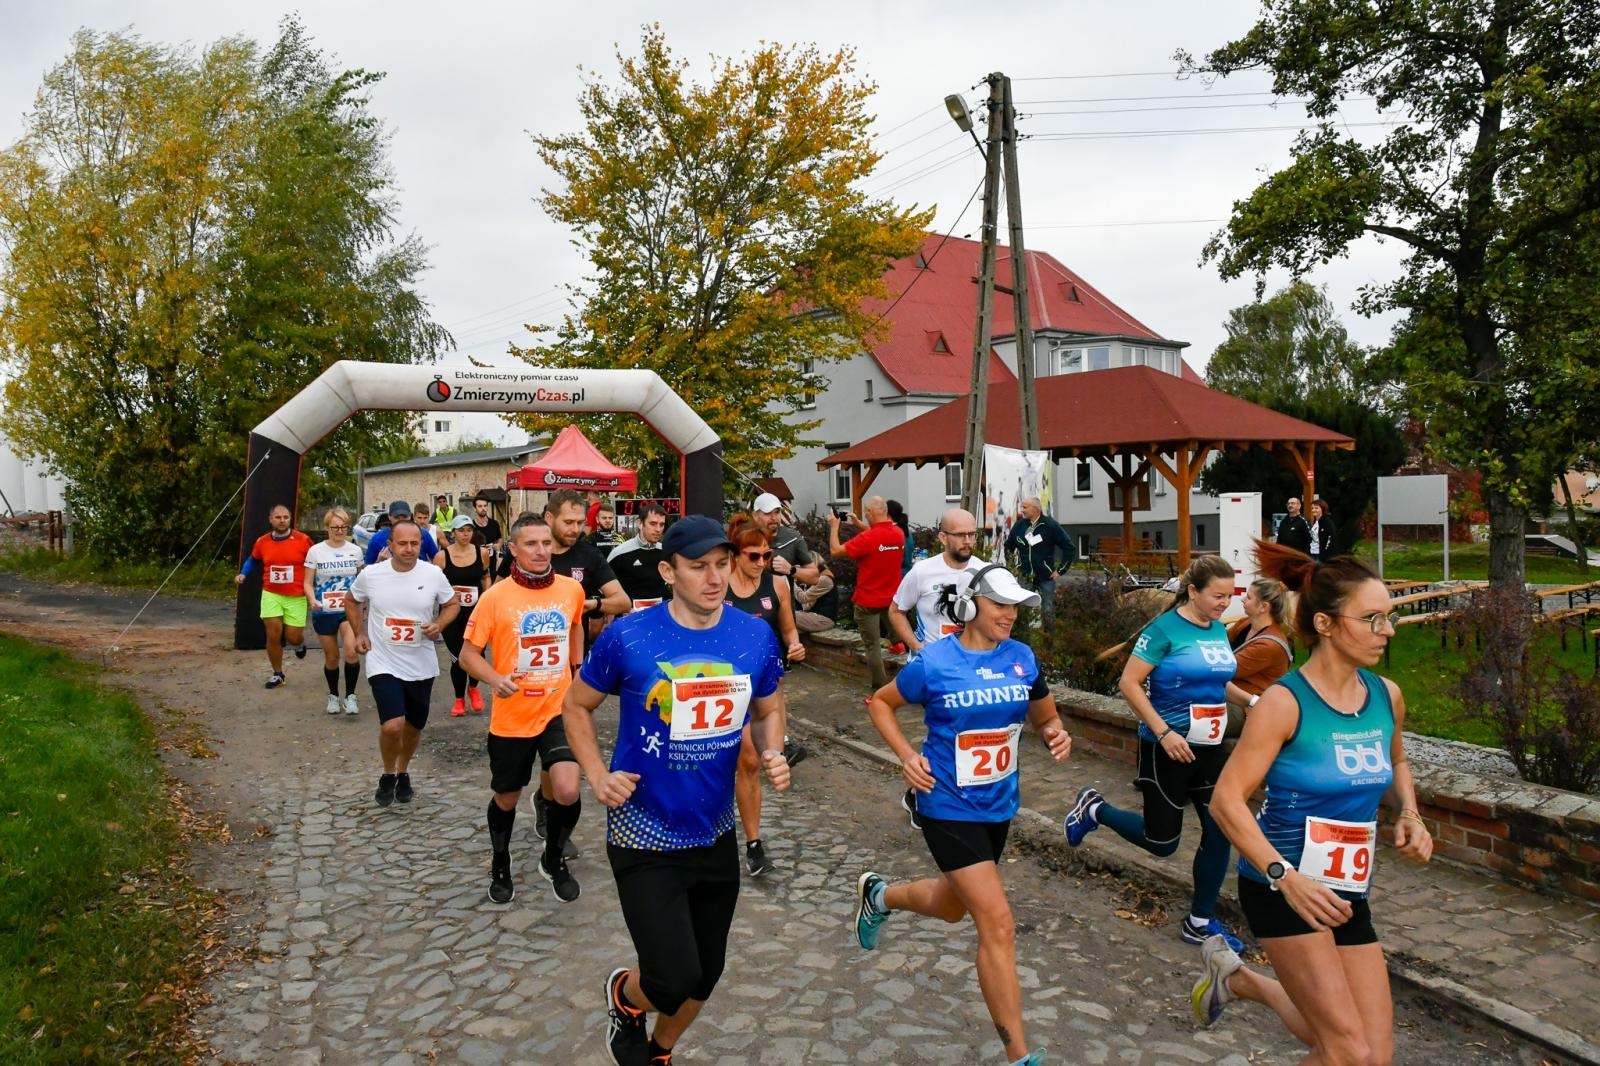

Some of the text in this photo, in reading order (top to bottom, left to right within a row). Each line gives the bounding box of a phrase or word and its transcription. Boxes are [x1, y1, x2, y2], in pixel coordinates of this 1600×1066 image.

[455, 371, 518, 382] Elektroniczny
[520, 372, 551, 383] pomiar
[453, 386, 585, 404] ZmierzymyCzas.pl
[274, 572, 289, 581] 31
[328, 598, 345, 609] 22
[391, 627, 415, 642] 32
[530, 646, 560, 667] 25
[691, 698, 734, 730] 12
[1208, 719, 1221, 739] 3
[669, 742, 705, 751] RYBNICKI
[669, 751, 717, 762] KSIĘŻYCOWY
[971, 746, 1011, 777] 20
[1323, 847, 1370, 882] 19
